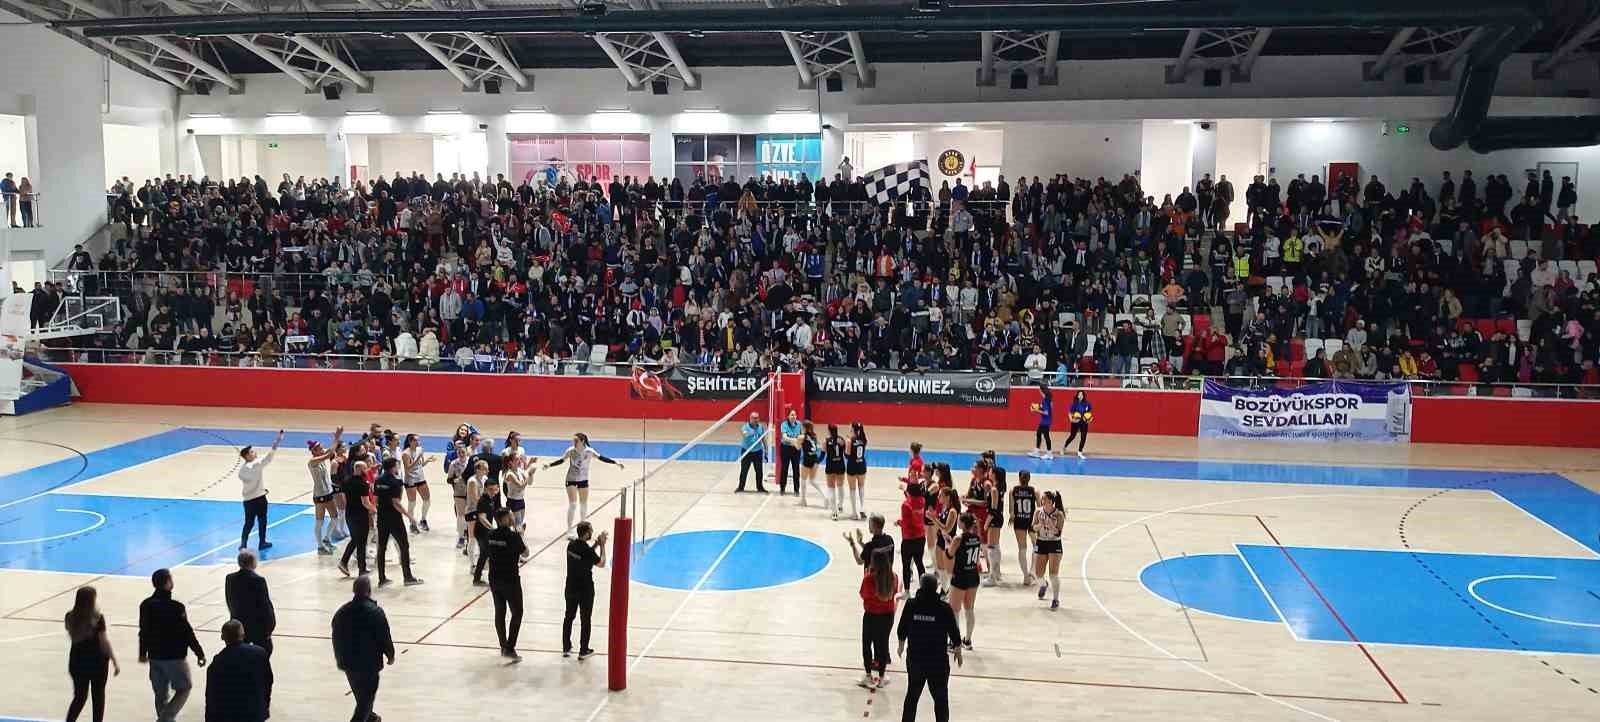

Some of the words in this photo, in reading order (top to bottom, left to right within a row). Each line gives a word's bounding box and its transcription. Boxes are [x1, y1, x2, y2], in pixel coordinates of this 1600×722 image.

[687, 375, 757, 393] ŞEHİTLER
[816, 376, 864, 392] VATAN
[868, 376, 954, 395] BÖLÜNMEZ.
[1234, 396, 1359, 413] BOZÜYÜKSPOR
[1242, 413, 1348, 428] SEVDALILARI
[1016, 498, 1031, 514] 10
[966, 547, 979, 565] 14
